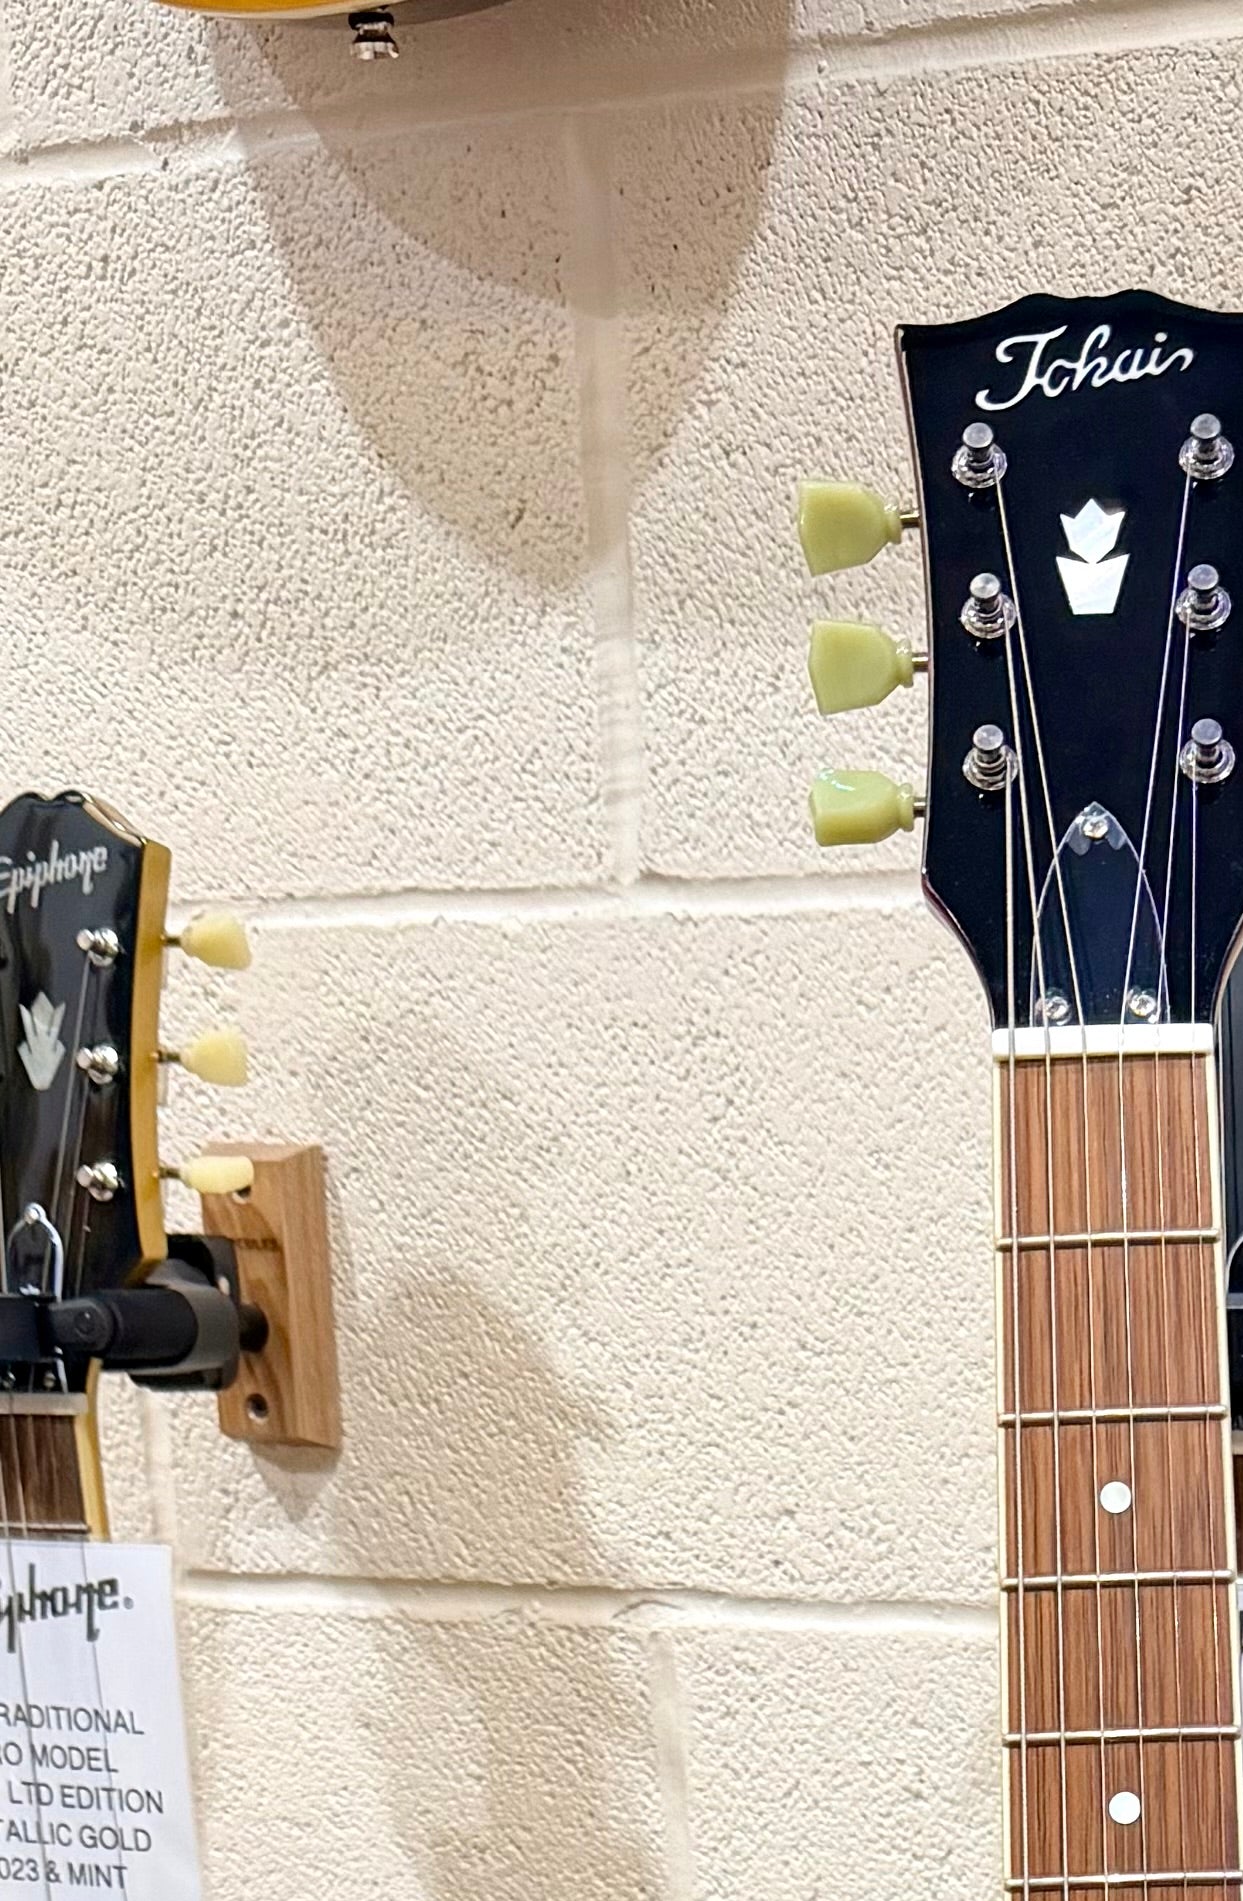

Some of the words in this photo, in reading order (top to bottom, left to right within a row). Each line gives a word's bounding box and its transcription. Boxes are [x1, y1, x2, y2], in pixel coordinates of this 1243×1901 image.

[975, 324, 1195, 411] Tokai
[0, 1562, 119, 1654] phone
[31, 1744, 119, 1773] MODEL
[8, 1780, 54, 1806] LTD
[61, 1784, 165, 1814] EDITION
[79, 1825, 152, 1853] GOLD
[46, 1860, 62, 1883] &
[68, 1862, 128, 1889] MINT
